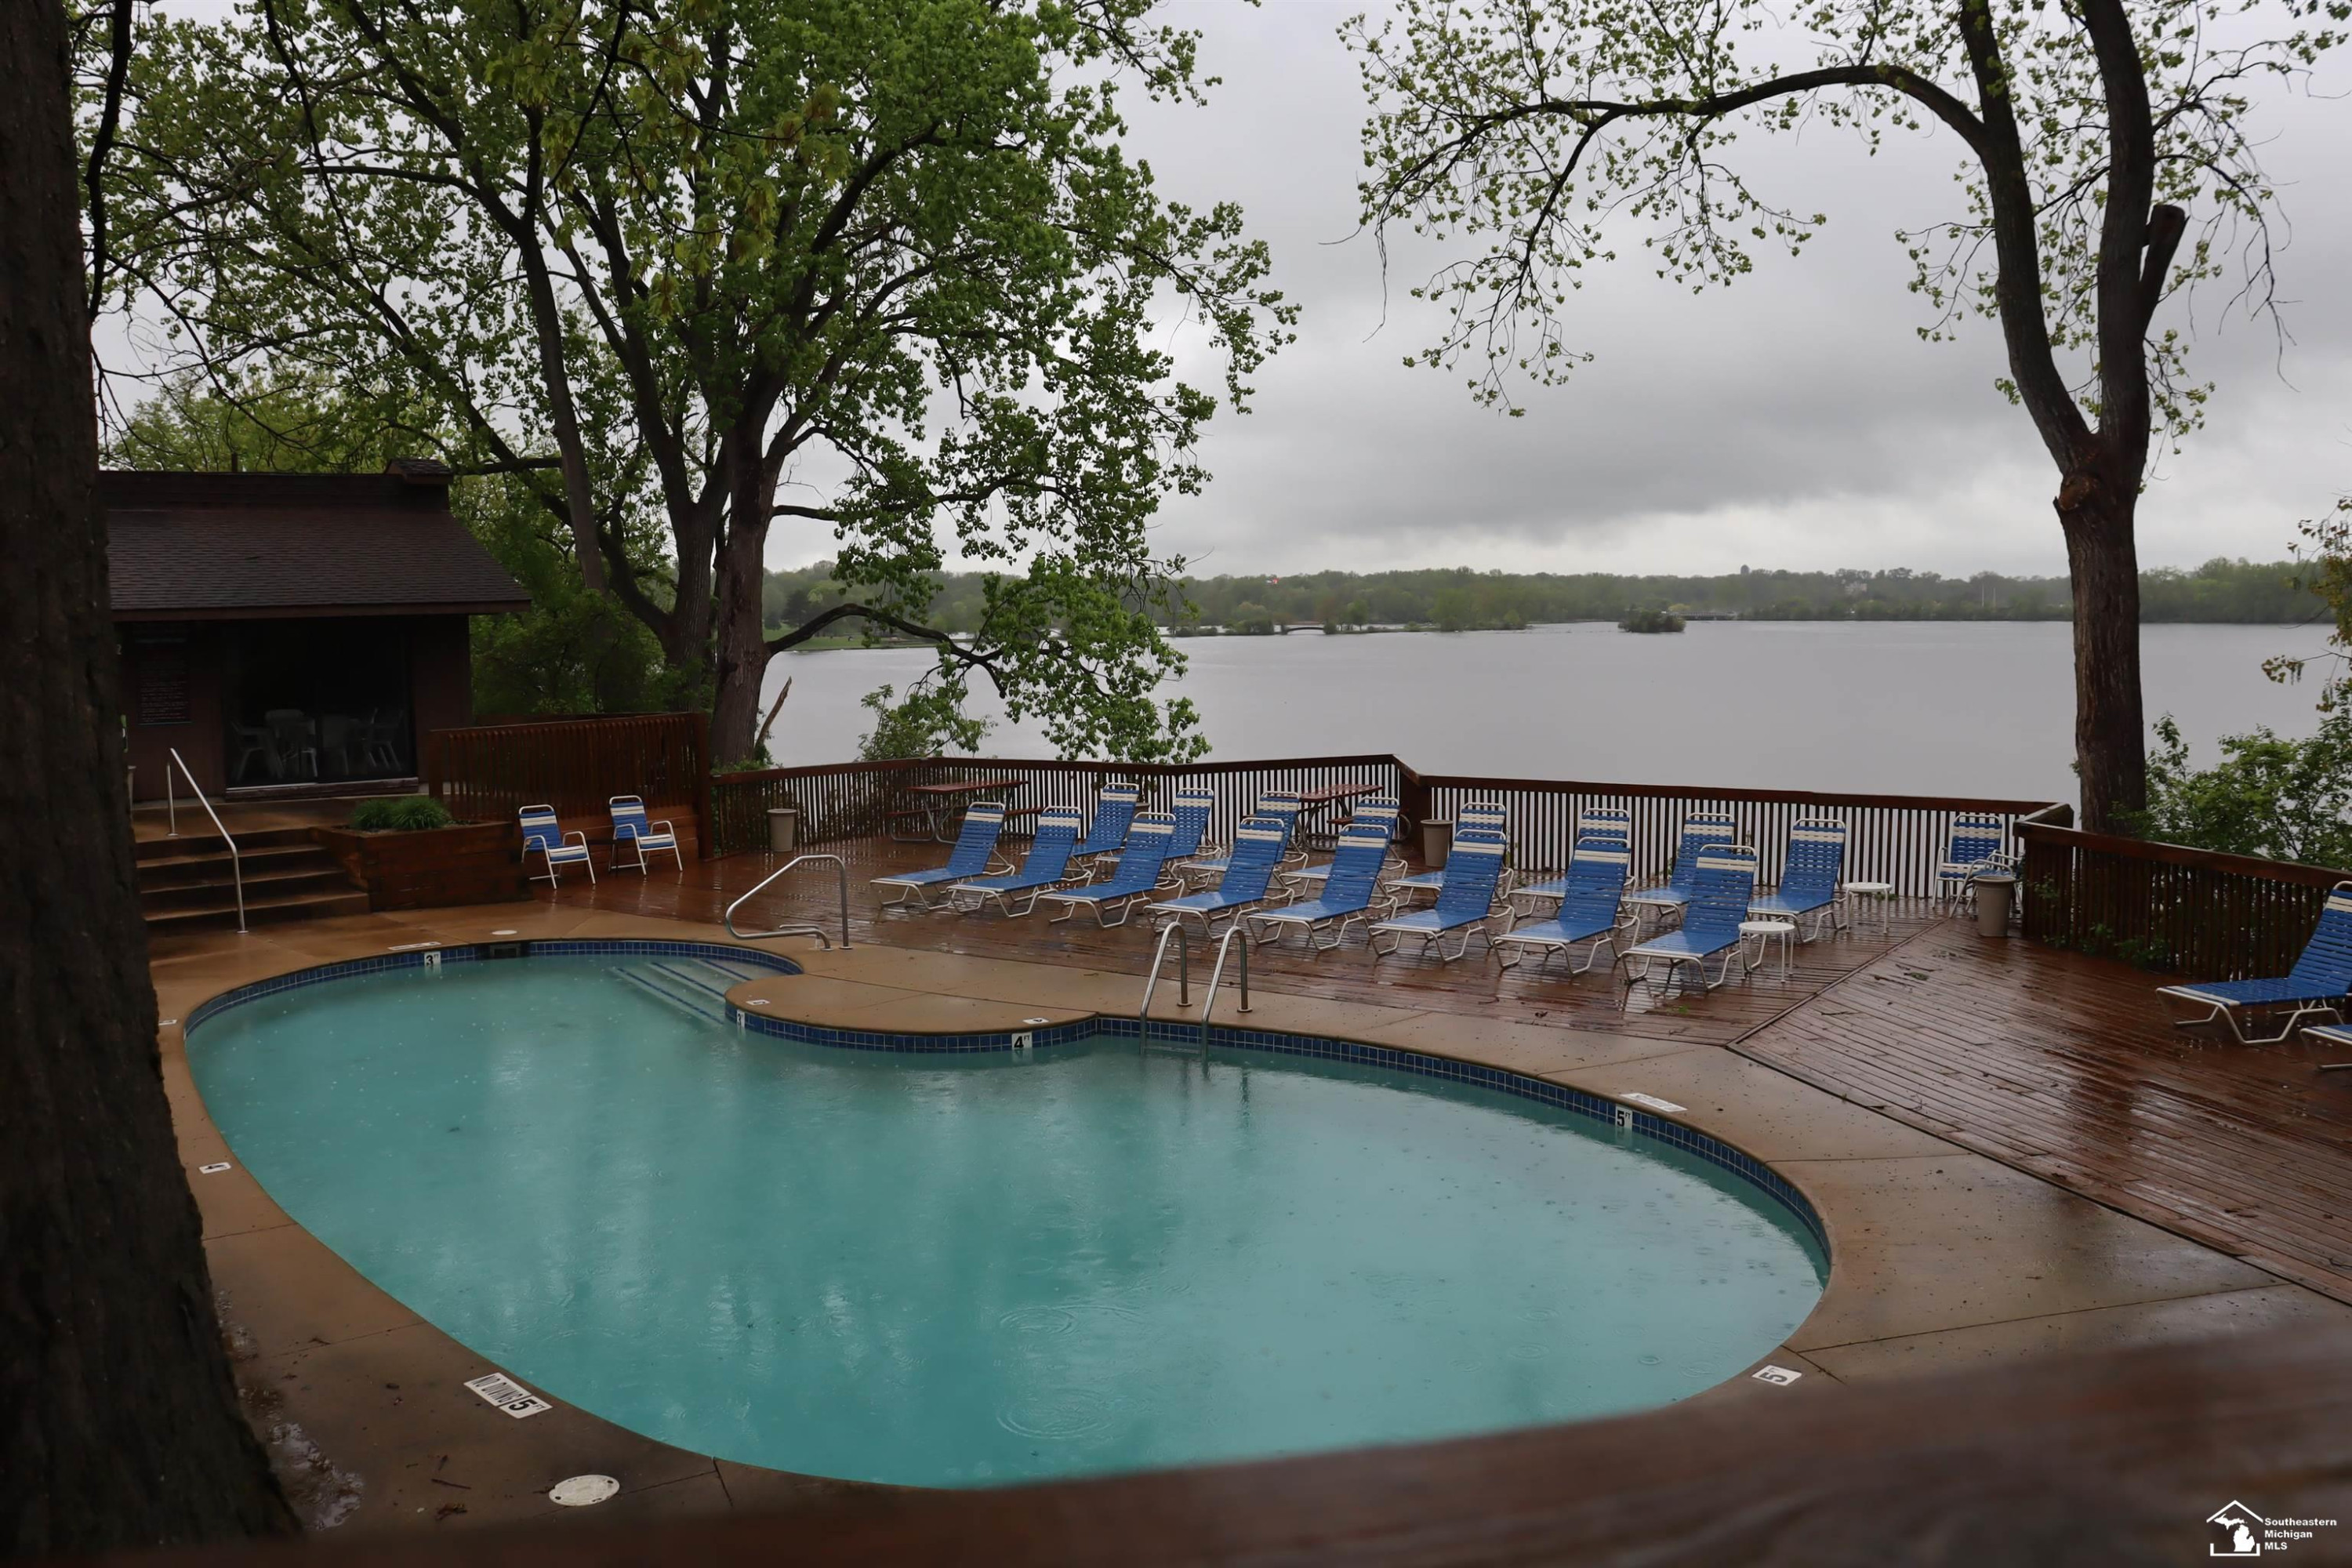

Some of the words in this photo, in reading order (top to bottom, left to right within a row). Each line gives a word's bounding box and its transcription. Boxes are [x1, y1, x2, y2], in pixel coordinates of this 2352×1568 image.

[426, 955, 434, 967] 3
[1014, 1036, 1024, 1048] 4
[1617, 1110, 1624, 1127] 5
[470, 1375, 500, 1387] NO
[1759, 1372, 1788, 1382] 5
[481, 1382, 523, 1403] DIVING
[509, 1399, 538, 1410] 5
